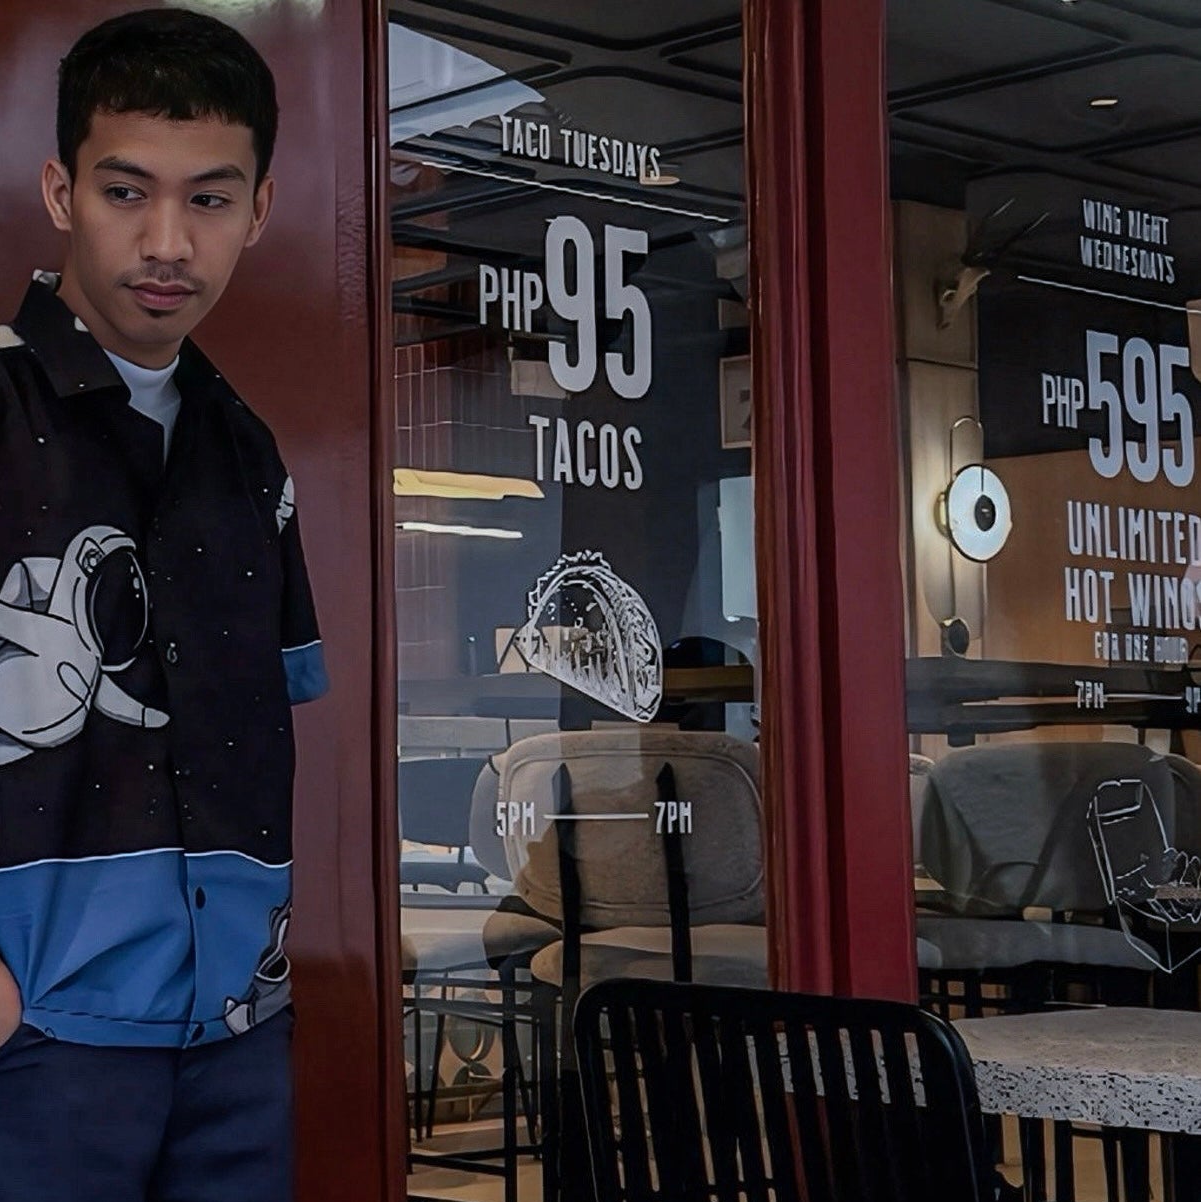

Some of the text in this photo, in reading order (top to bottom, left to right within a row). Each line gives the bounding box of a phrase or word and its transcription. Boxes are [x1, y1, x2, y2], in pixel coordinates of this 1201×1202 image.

[500, 115, 661, 180] TACO TUESDAYS
[1083, 199, 1169, 245] WING NIGHT
[1080, 235, 1176, 284] WEDNESDAYS
[545, 216, 652, 399] 95
[1086, 329, 1195, 487] 595
[528, 414, 644, 491] TACOS
[1067, 500, 1201, 567] UNLIMITED
[1064, 566, 1115, 624] HOT
